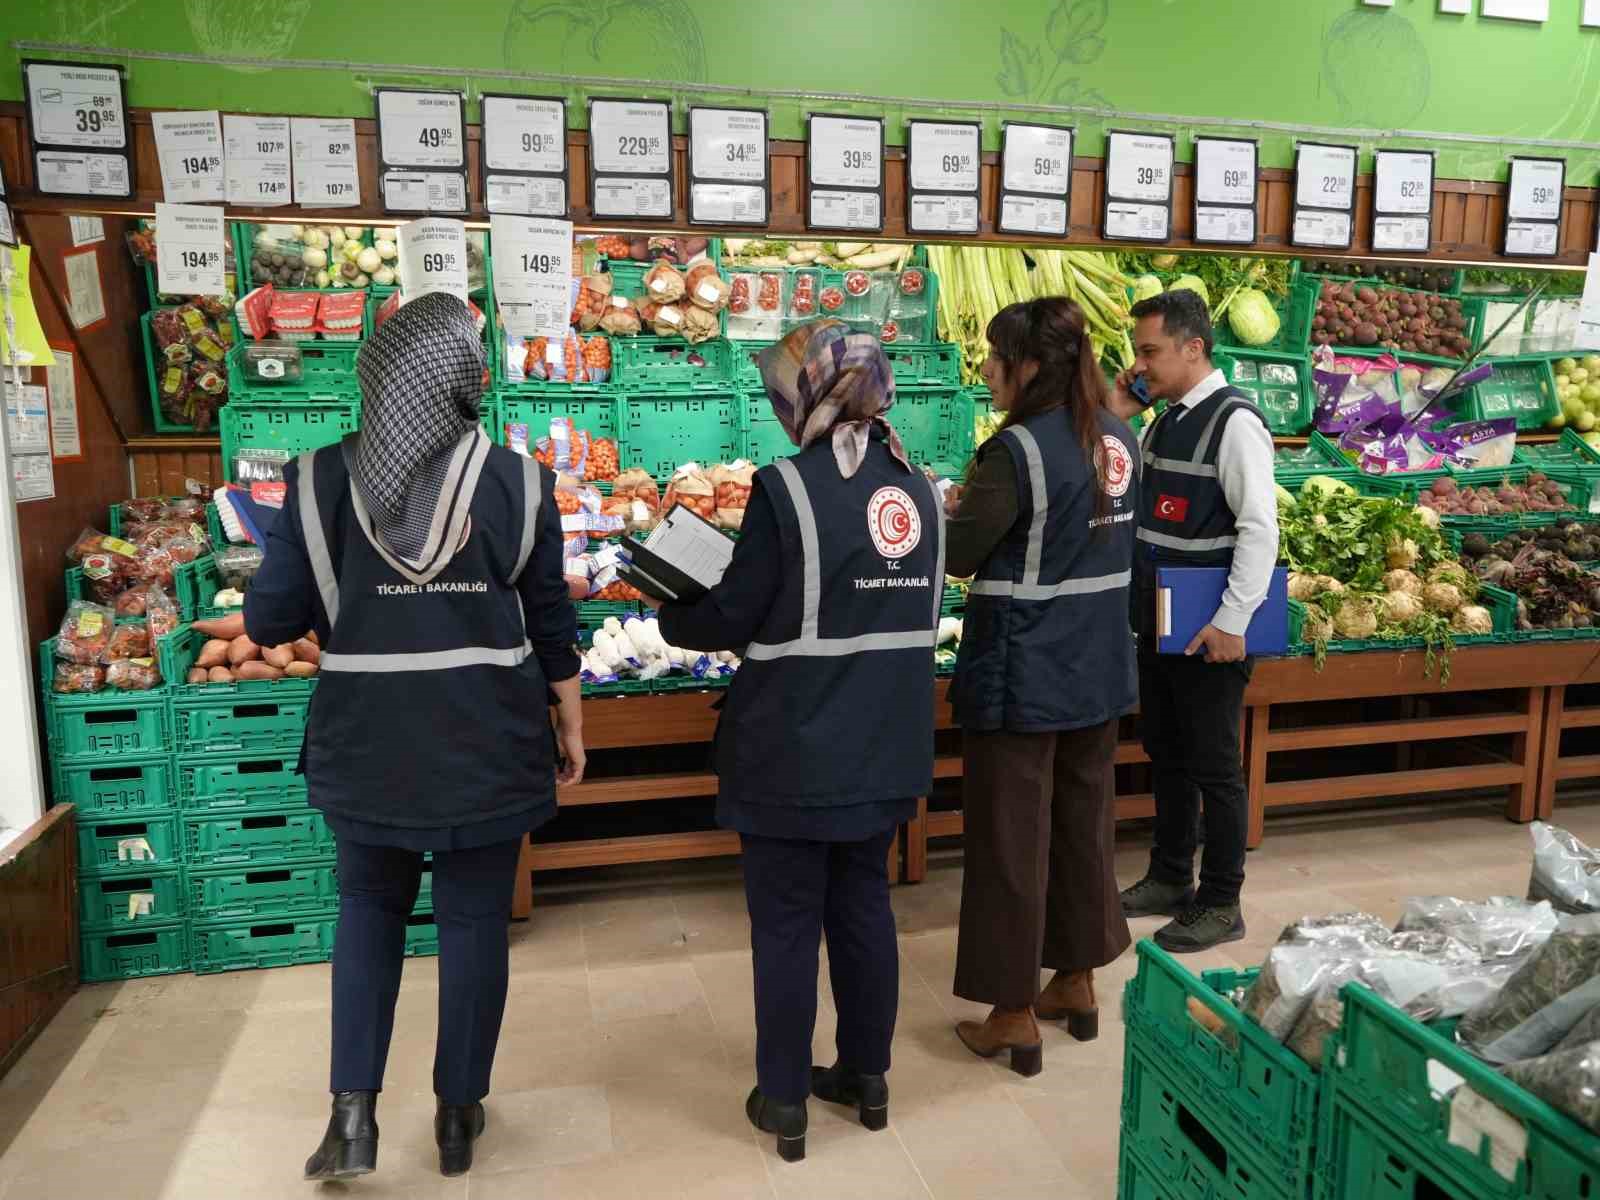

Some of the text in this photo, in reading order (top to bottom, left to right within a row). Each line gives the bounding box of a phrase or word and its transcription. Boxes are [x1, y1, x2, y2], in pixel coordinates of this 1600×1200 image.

[426, 581, 488, 593] BAKANLIĞI
[854, 576, 929, 589] TİCARET BAKANLIĞI
